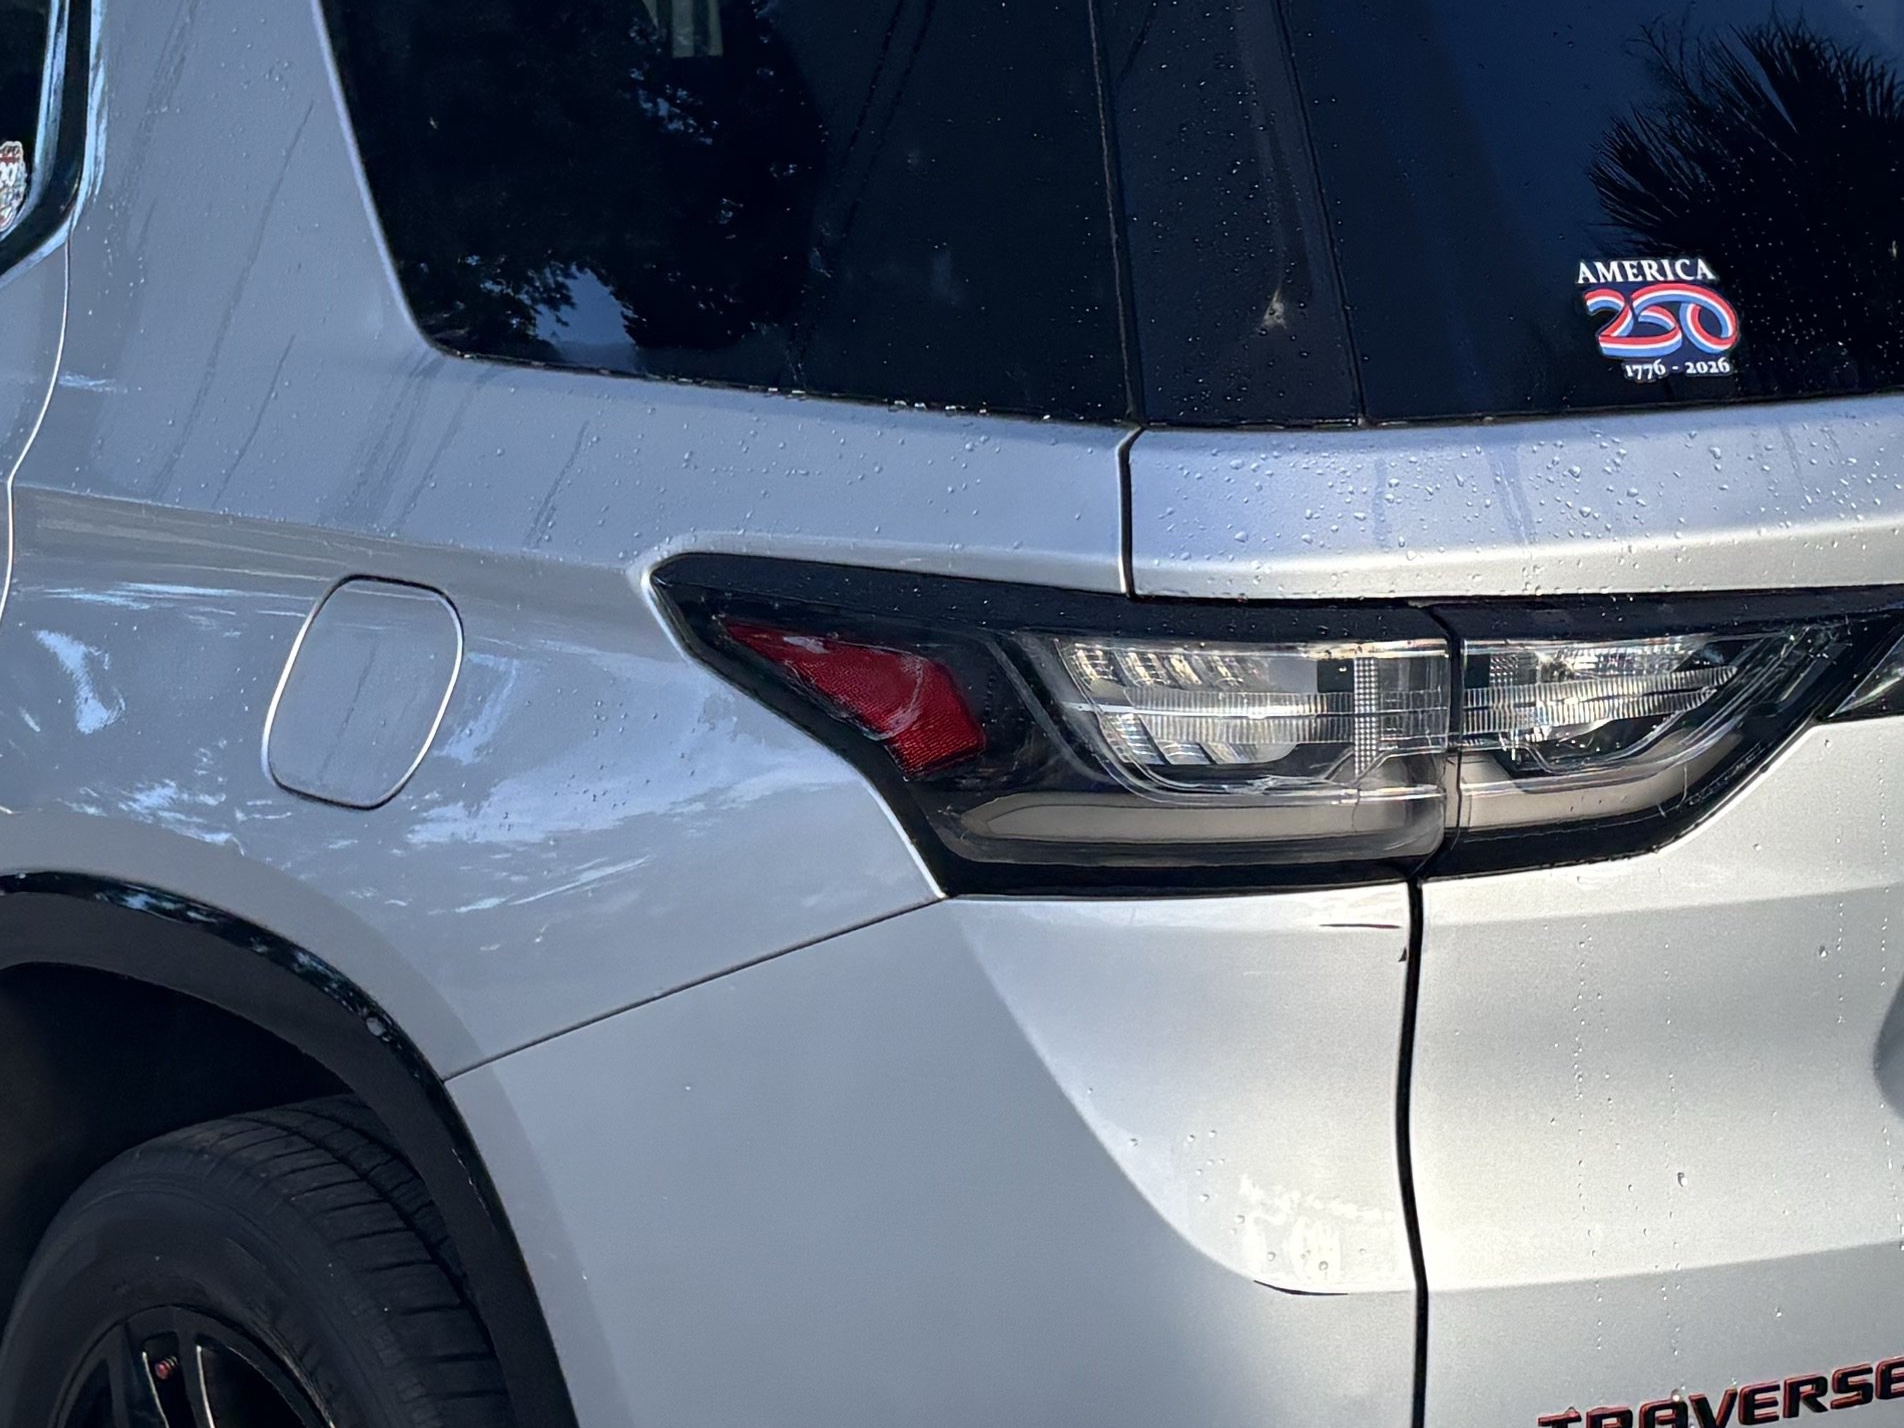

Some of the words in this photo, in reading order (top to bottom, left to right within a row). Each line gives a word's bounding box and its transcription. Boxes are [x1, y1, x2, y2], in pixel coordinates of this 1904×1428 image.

[1577, 259, 1715, 283] AMERICA
[1584, 283, 1738, 357] 250
[1625, 359, 1666, 380] 1776
[1685, 358, 1730, 374] 2026
